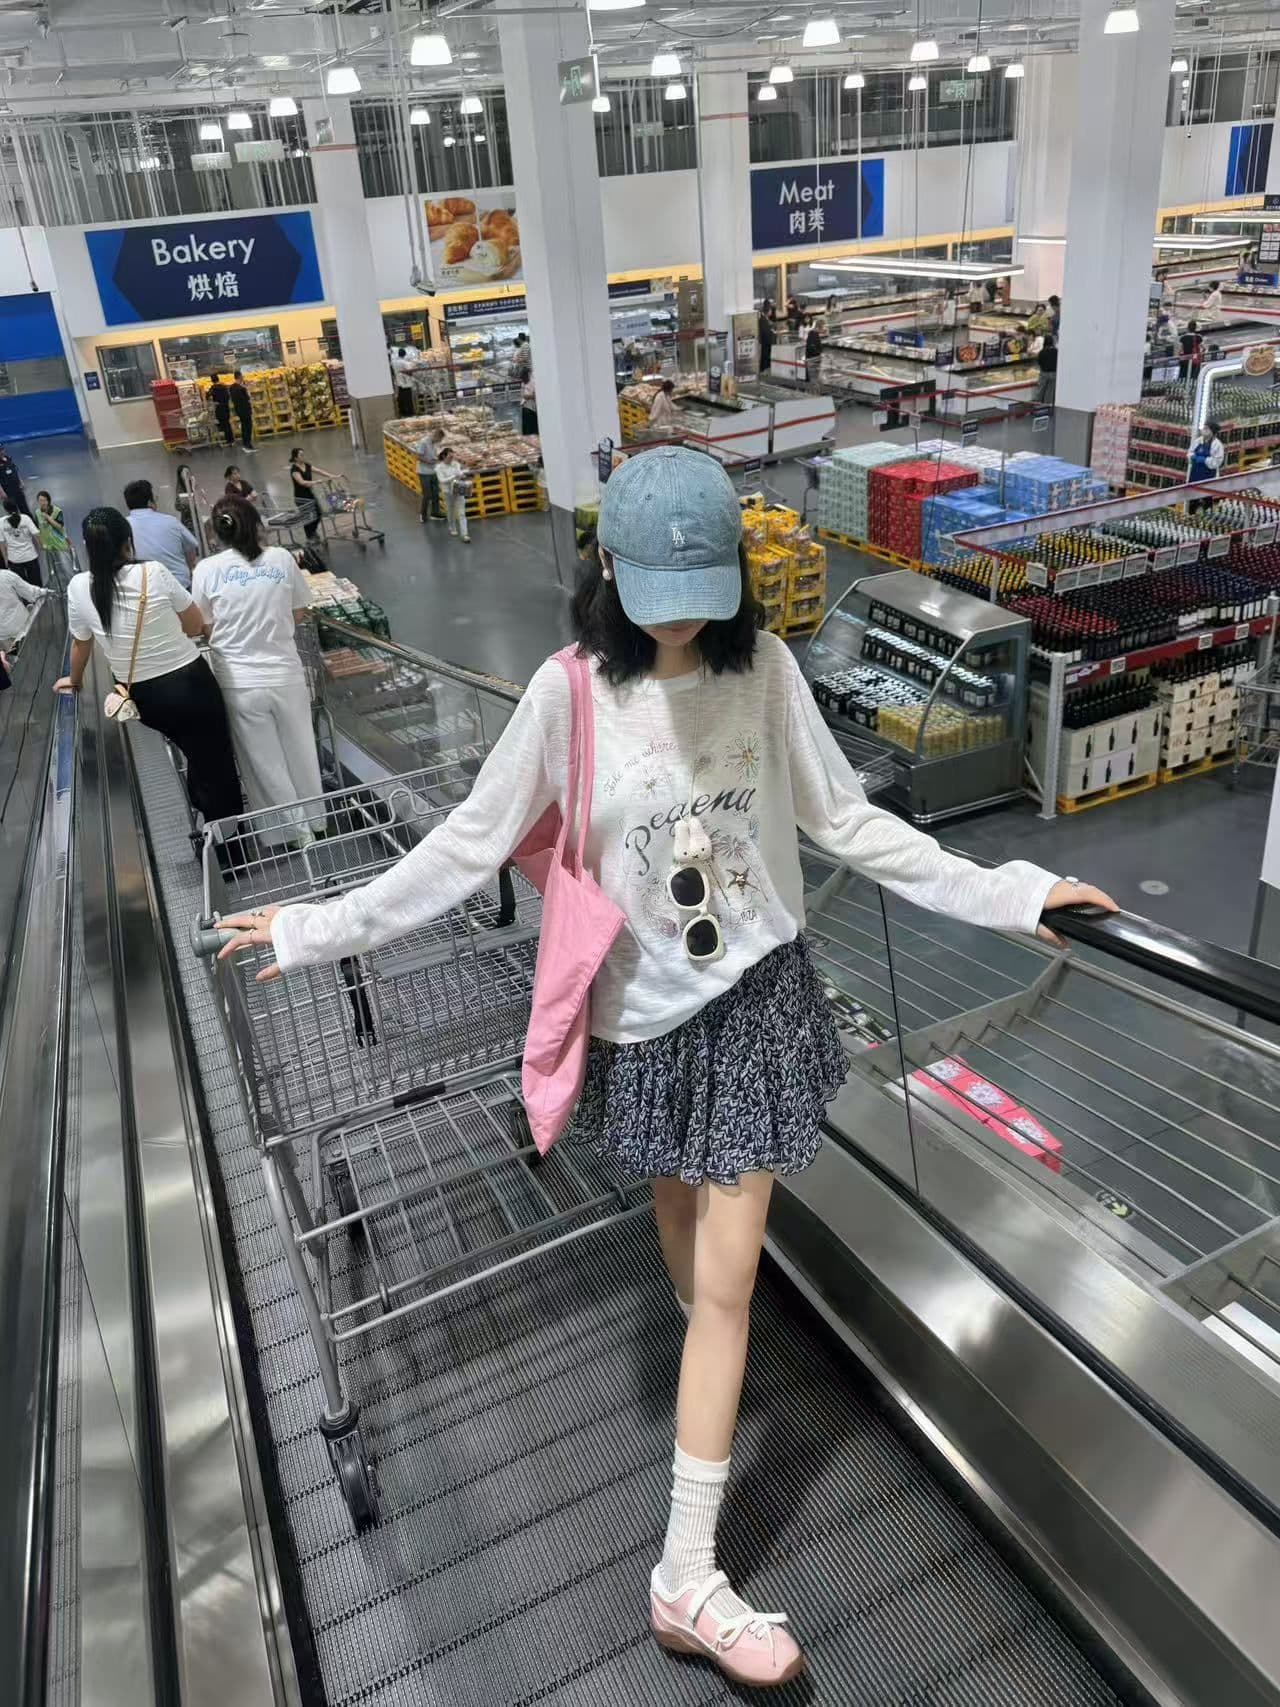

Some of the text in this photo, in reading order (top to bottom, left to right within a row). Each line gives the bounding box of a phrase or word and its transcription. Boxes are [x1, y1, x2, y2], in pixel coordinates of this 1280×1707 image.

[779, 179, 835, 205] Meat
[789, 208, 825, 234] 肉类
[151, 234, 255, 266] Bakery
[187, 271, 240, 301] 烘焙
[671, 527, 686, 545] LA
